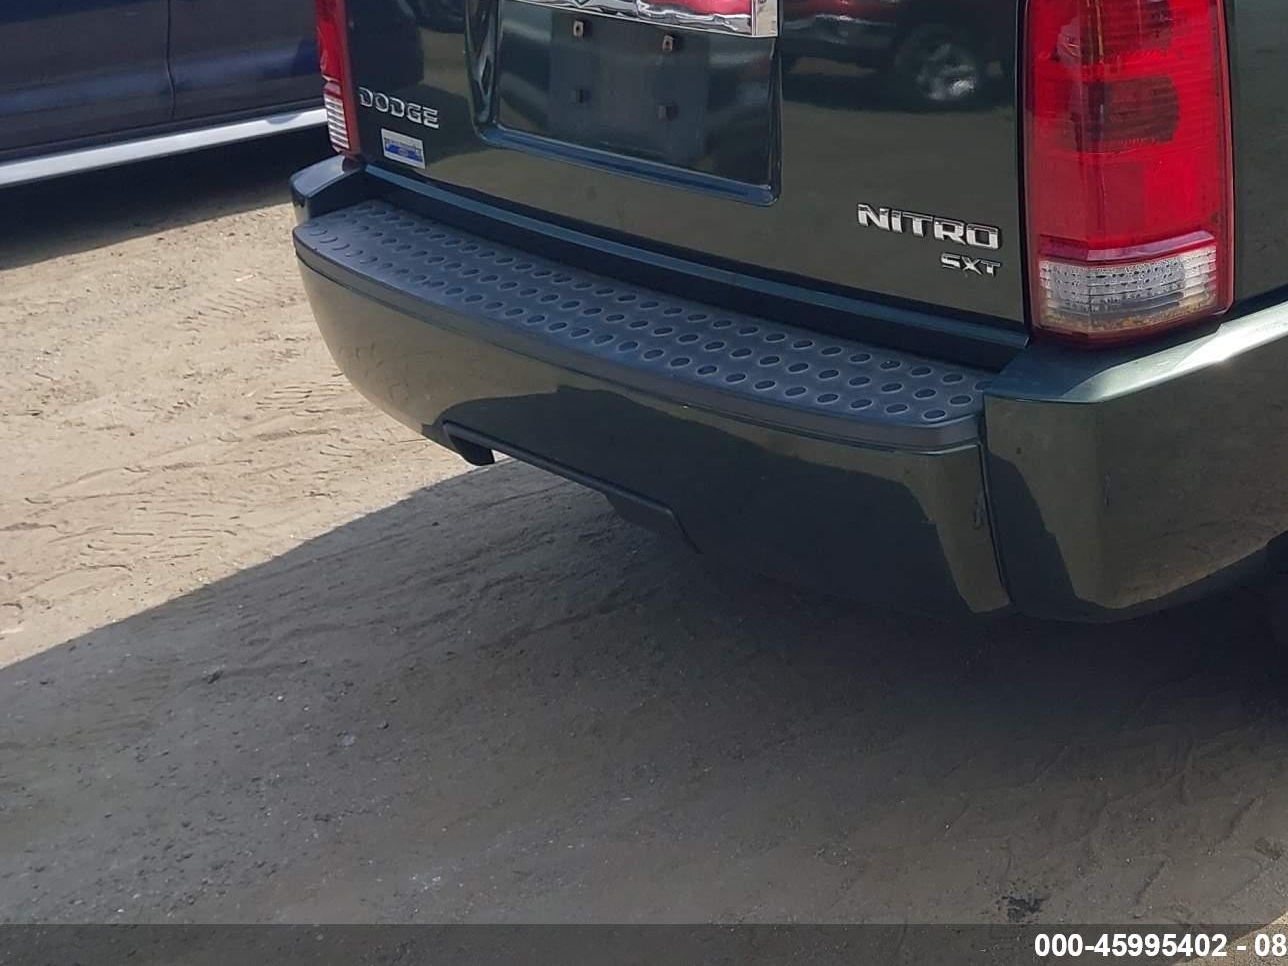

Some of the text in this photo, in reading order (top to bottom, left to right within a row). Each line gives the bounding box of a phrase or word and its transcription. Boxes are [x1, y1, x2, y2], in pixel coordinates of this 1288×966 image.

[358, 86, 440, 129] DODGE
[857, 203, 1001, 250] NITRO
[940, 252, 1001, 276] SXT
